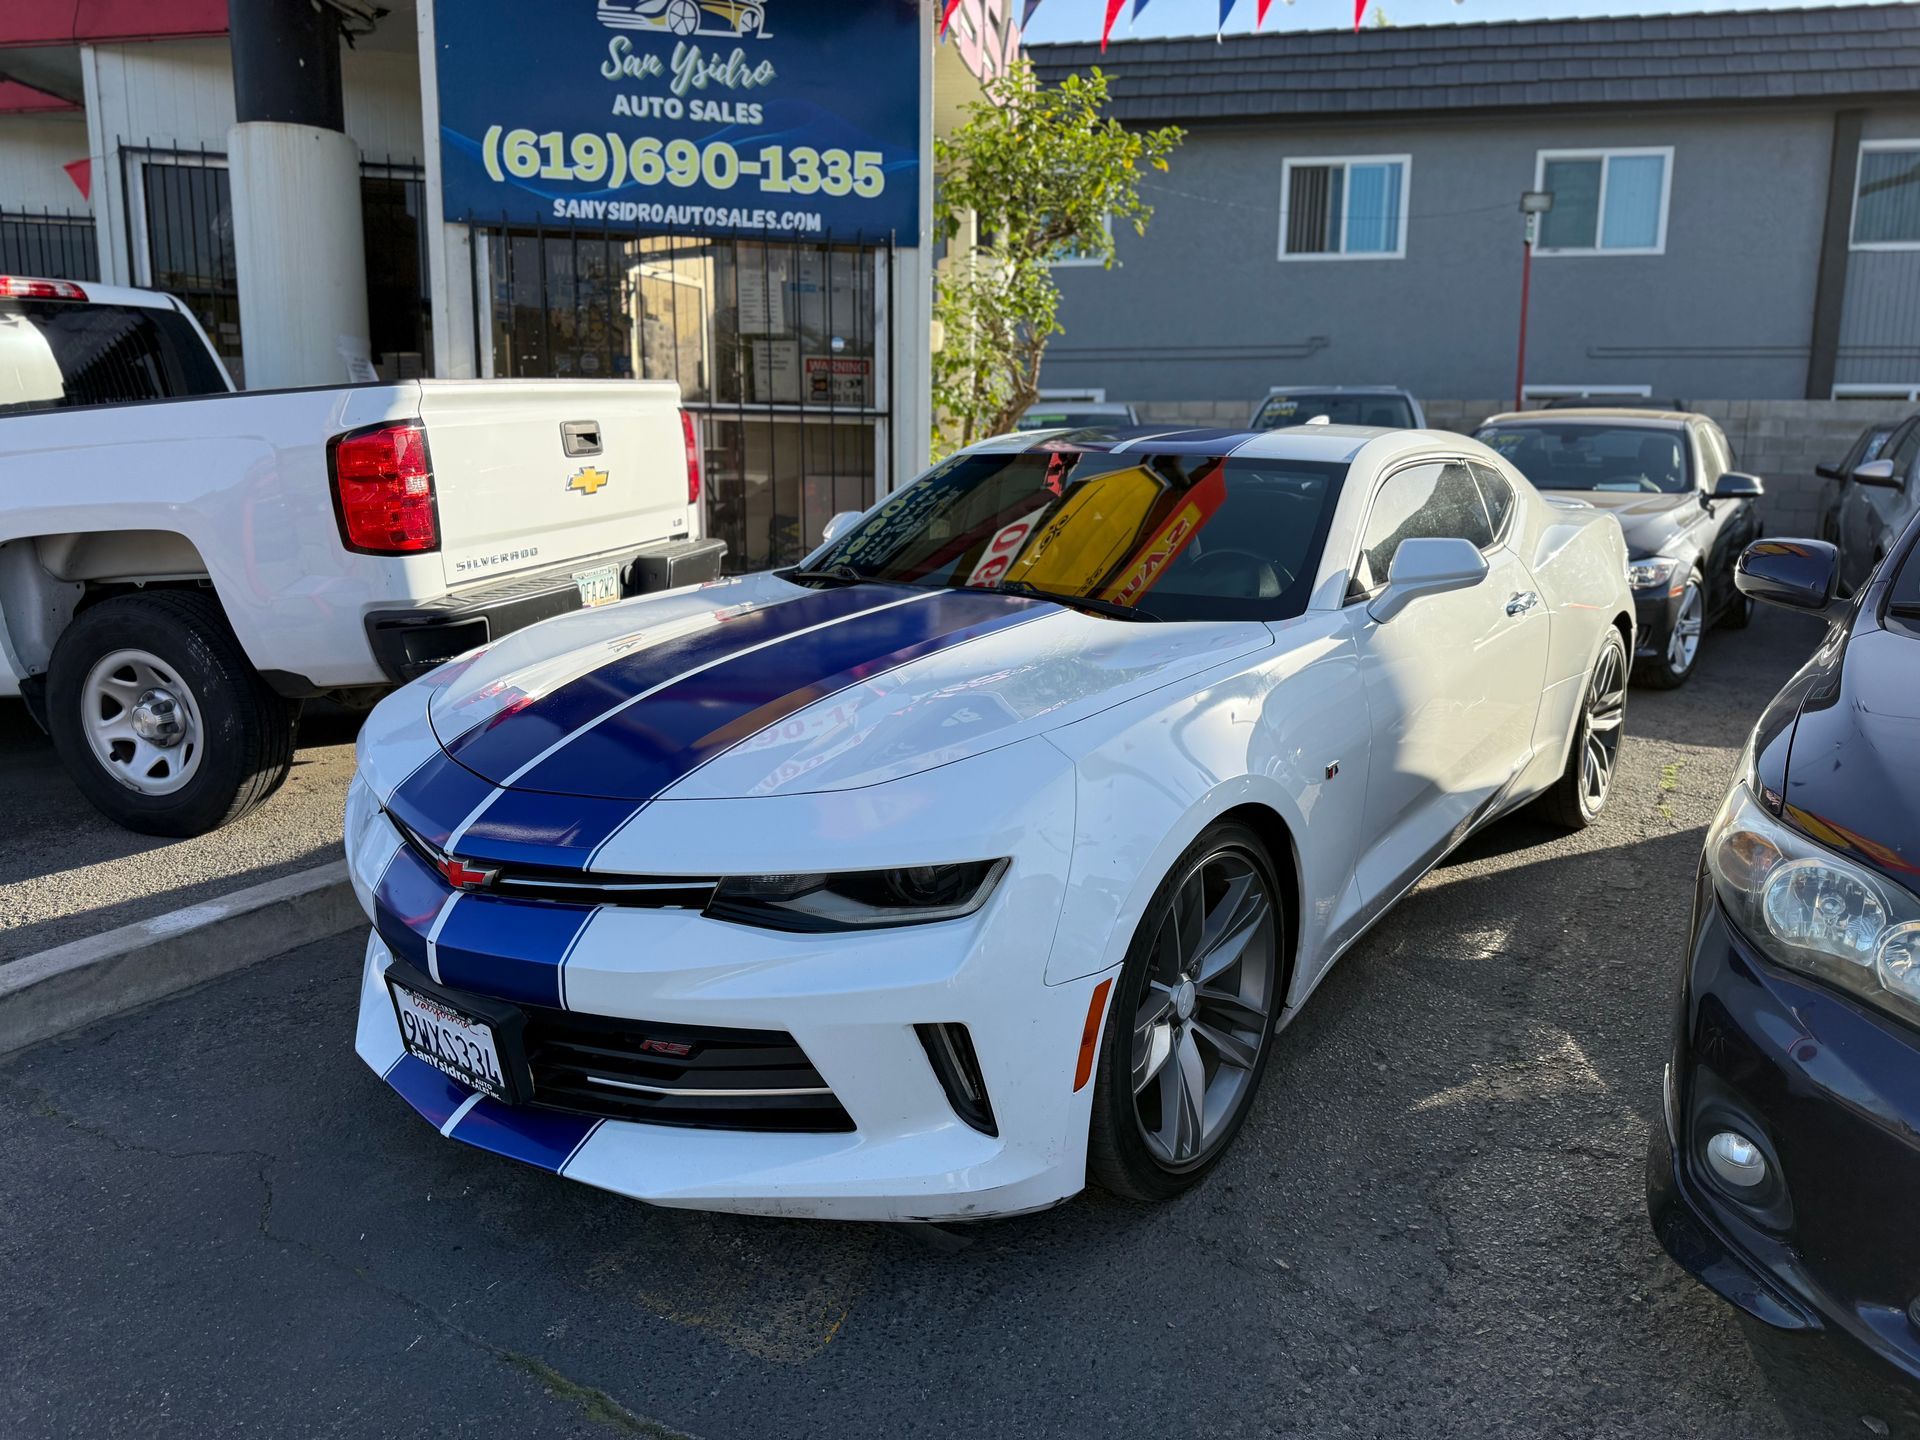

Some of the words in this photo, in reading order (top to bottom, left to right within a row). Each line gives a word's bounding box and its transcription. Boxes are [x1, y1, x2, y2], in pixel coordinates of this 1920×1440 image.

[600, 34, 665, 81] San
[670, 40, 778, 97] Ysidro
[612, 94, 684, 120] AUTO
[689, 99, 764, 125] SALES
[482, 125, 886, 198] (619)690-1335
[553, 198, 822, 232] SANYSIDROAUTOSALES.COM
[456, 546, 539, 572] SILVERADO
[402, 1010, 502, 1086] 9WXS334
[640, 1039, 692, 1056] RS
